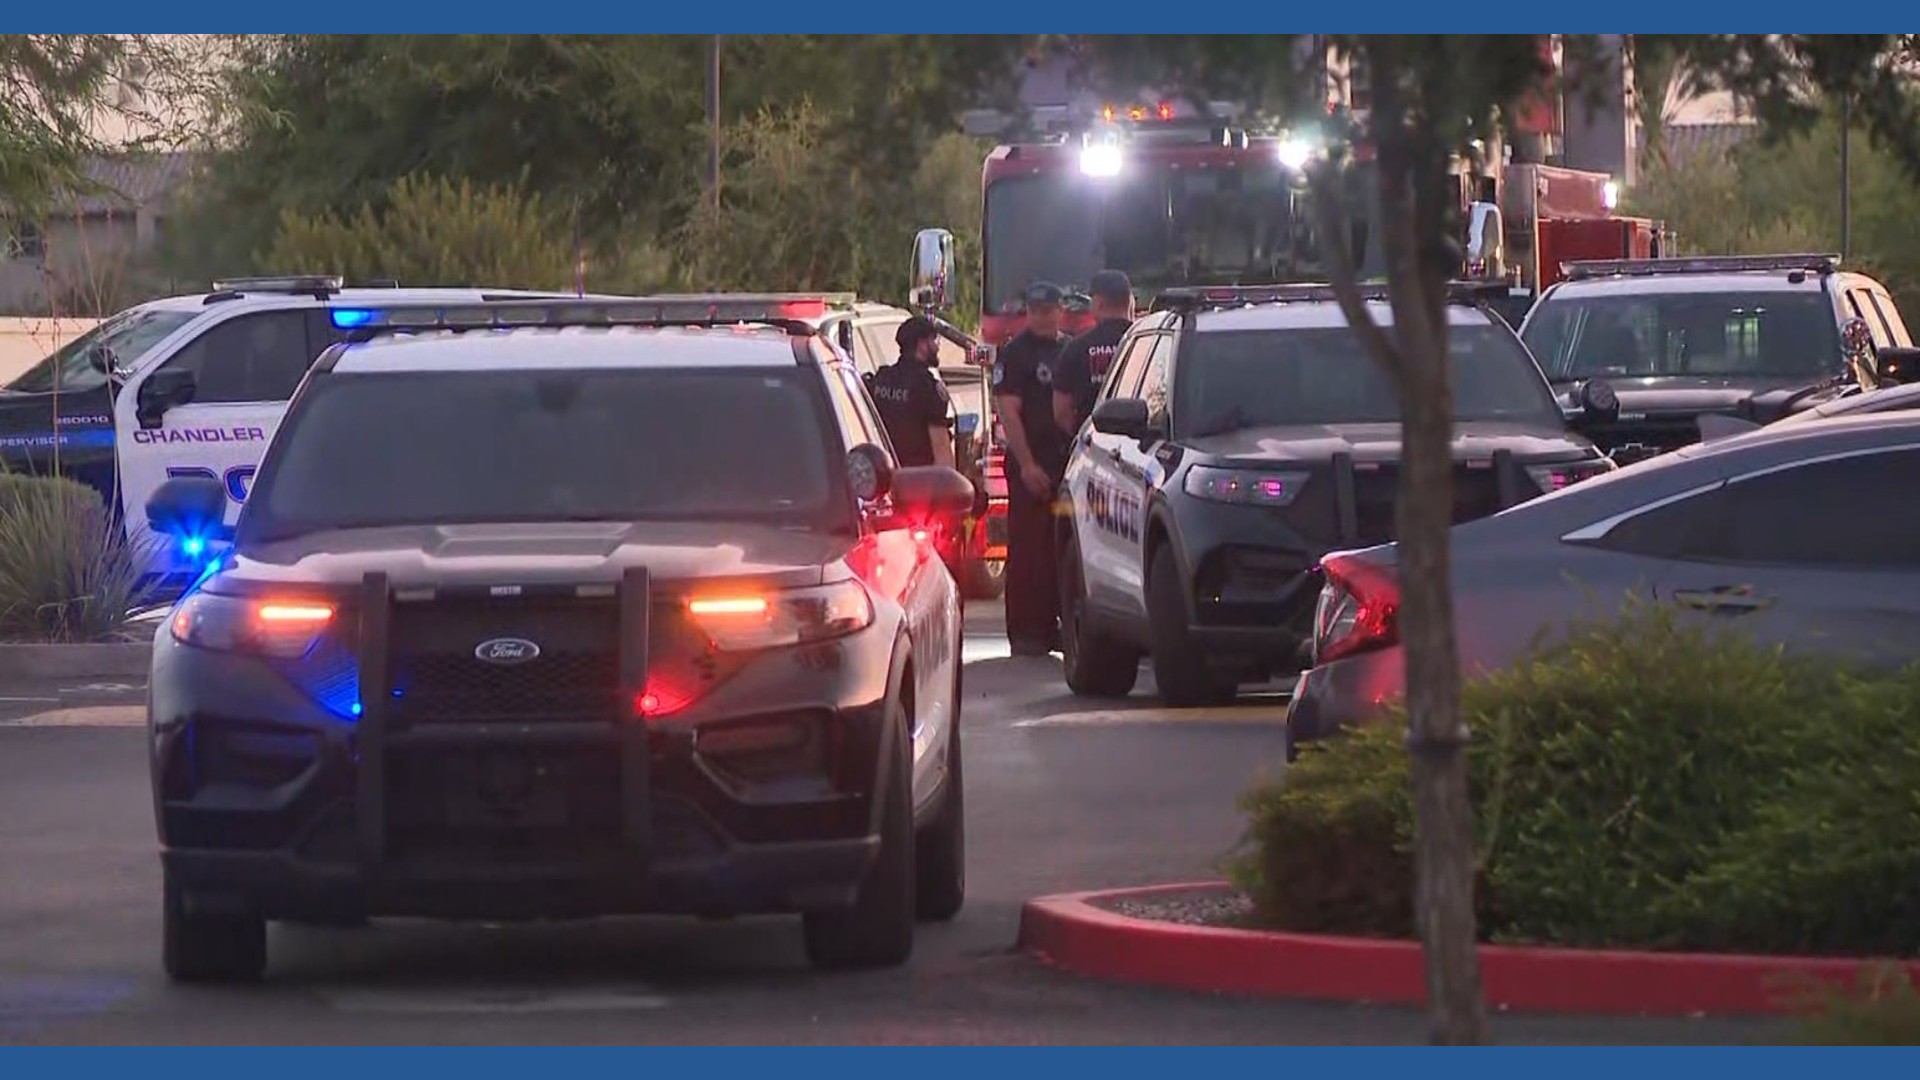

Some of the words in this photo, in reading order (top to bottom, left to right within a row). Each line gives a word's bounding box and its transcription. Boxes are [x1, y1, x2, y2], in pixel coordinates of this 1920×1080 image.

[873, 384, 909, 401] POLICE
[133, 427, 265, 443] CHANDLER
[490, 642, 525, 658] Ford
